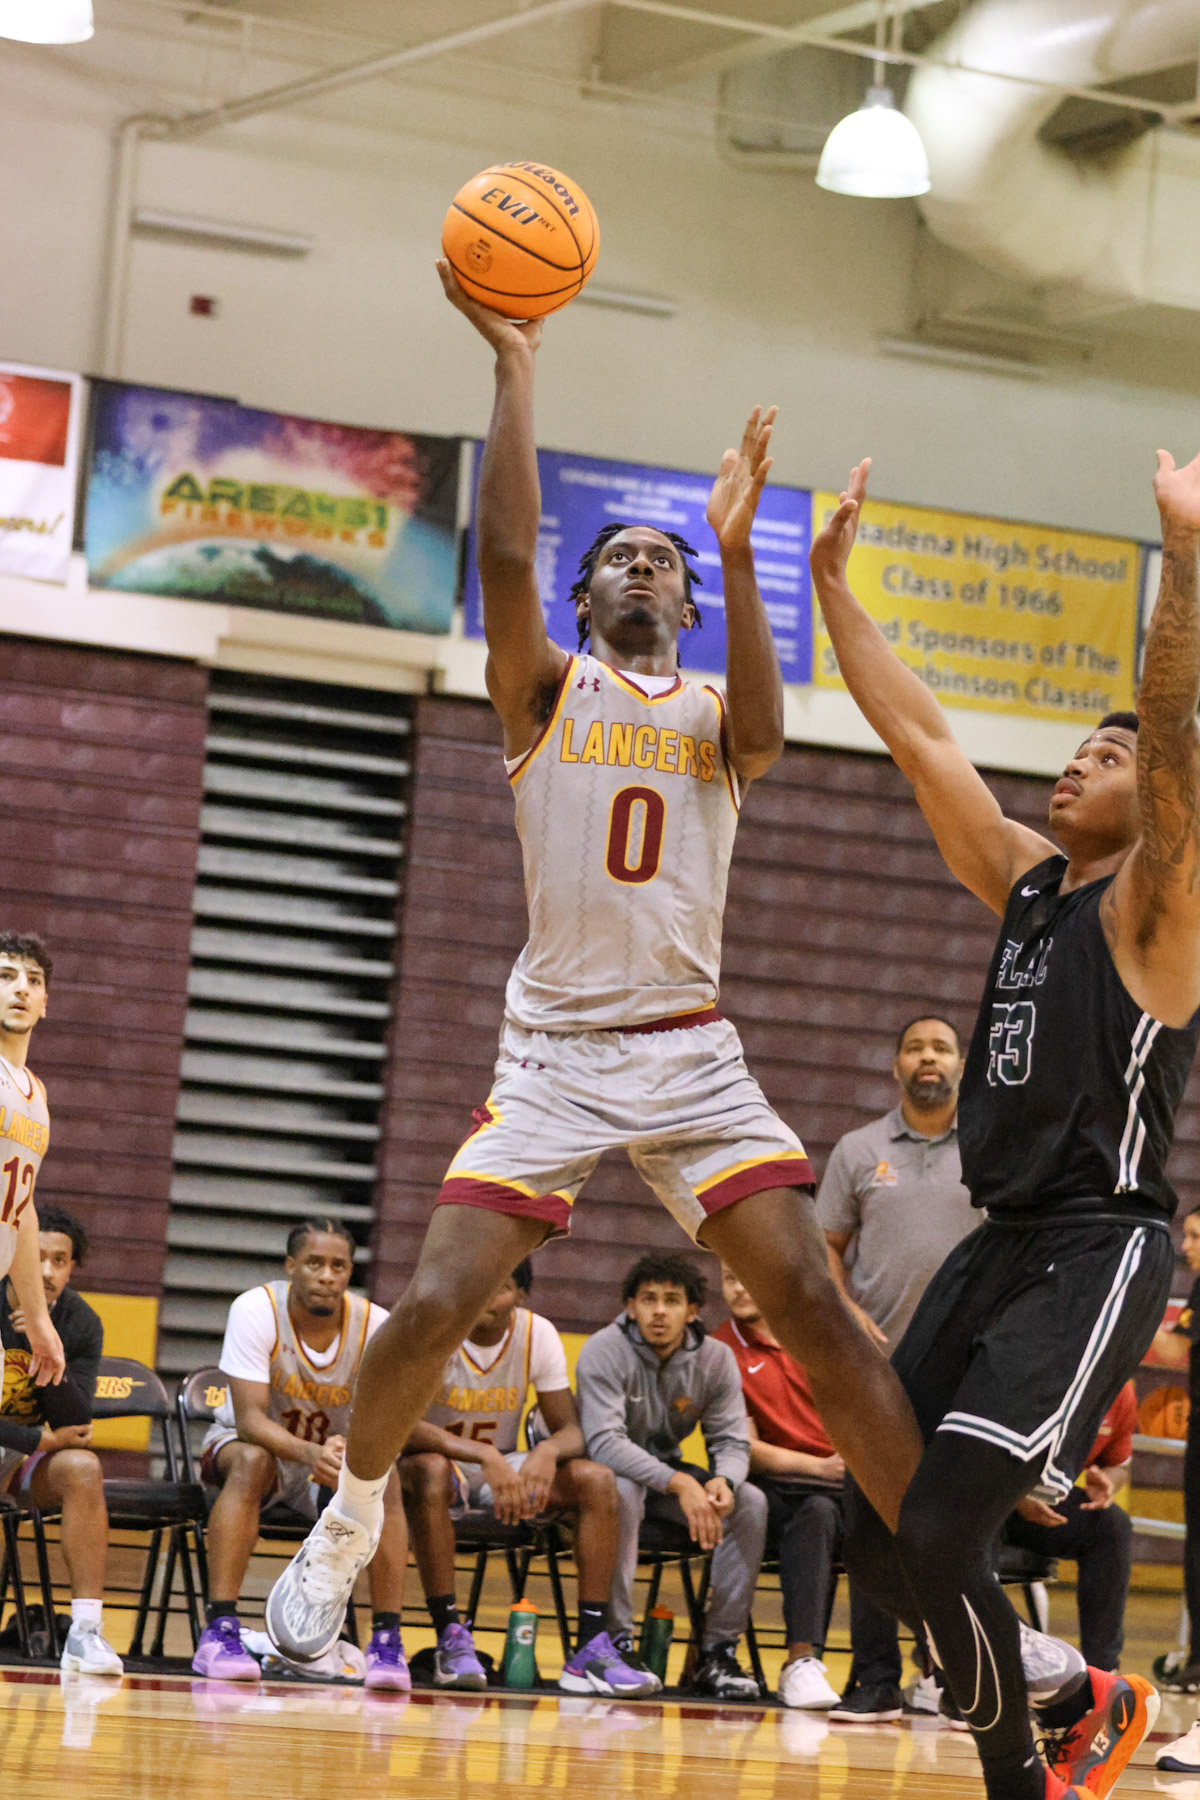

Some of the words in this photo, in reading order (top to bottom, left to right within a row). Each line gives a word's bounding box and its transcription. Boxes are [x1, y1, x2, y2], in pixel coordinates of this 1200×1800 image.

[823, 509, 956, 558] sadena
[963, 531, 1030, 573] High
[1036, 543, 1128, 584] School
[881, 563, 953, 600] Class
[960, 577, 988, 605] of
[1000, 583, 1062, 618] 1966
[907, 619, 1035, 666] Sponsors
[1040, 640, 1067, 668] of
[1074, 643, 1120, 676] The
[1024, 676, 1111, 712] Classic
[560, 718, 716, 783] LANCERS
[604, 784, 667, 886] 0
[2, 1156, 35, 1231] 12
[1089, 1731, 1111, 1758] 13
